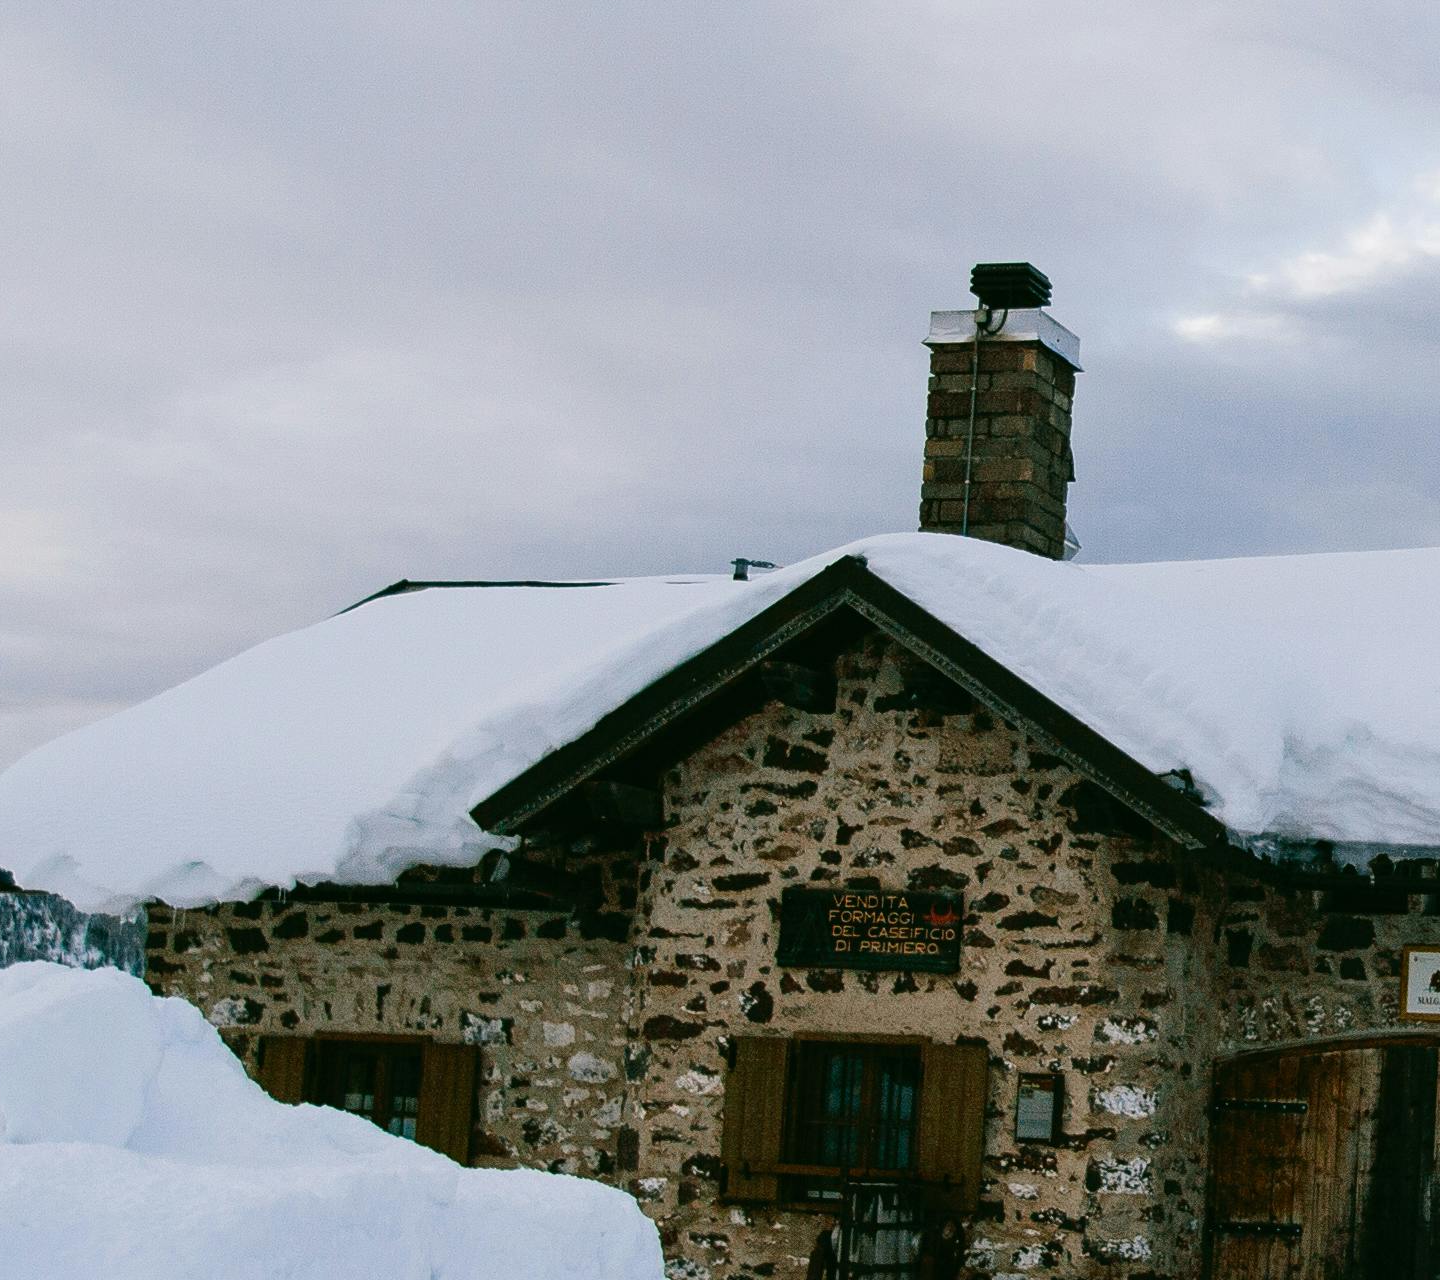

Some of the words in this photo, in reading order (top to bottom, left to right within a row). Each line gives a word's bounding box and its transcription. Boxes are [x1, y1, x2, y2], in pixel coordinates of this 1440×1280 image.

[833, 895, 908, 908] VENDITA
[829, 910, 914, 924] FORMAGGI
[832, 926, 860, 937] DEL
[868, 927, 955, 940] CASEIFICIO
[835, 940, 850, 952] DI
[860, 941, 939, 954] PRIMIERO
